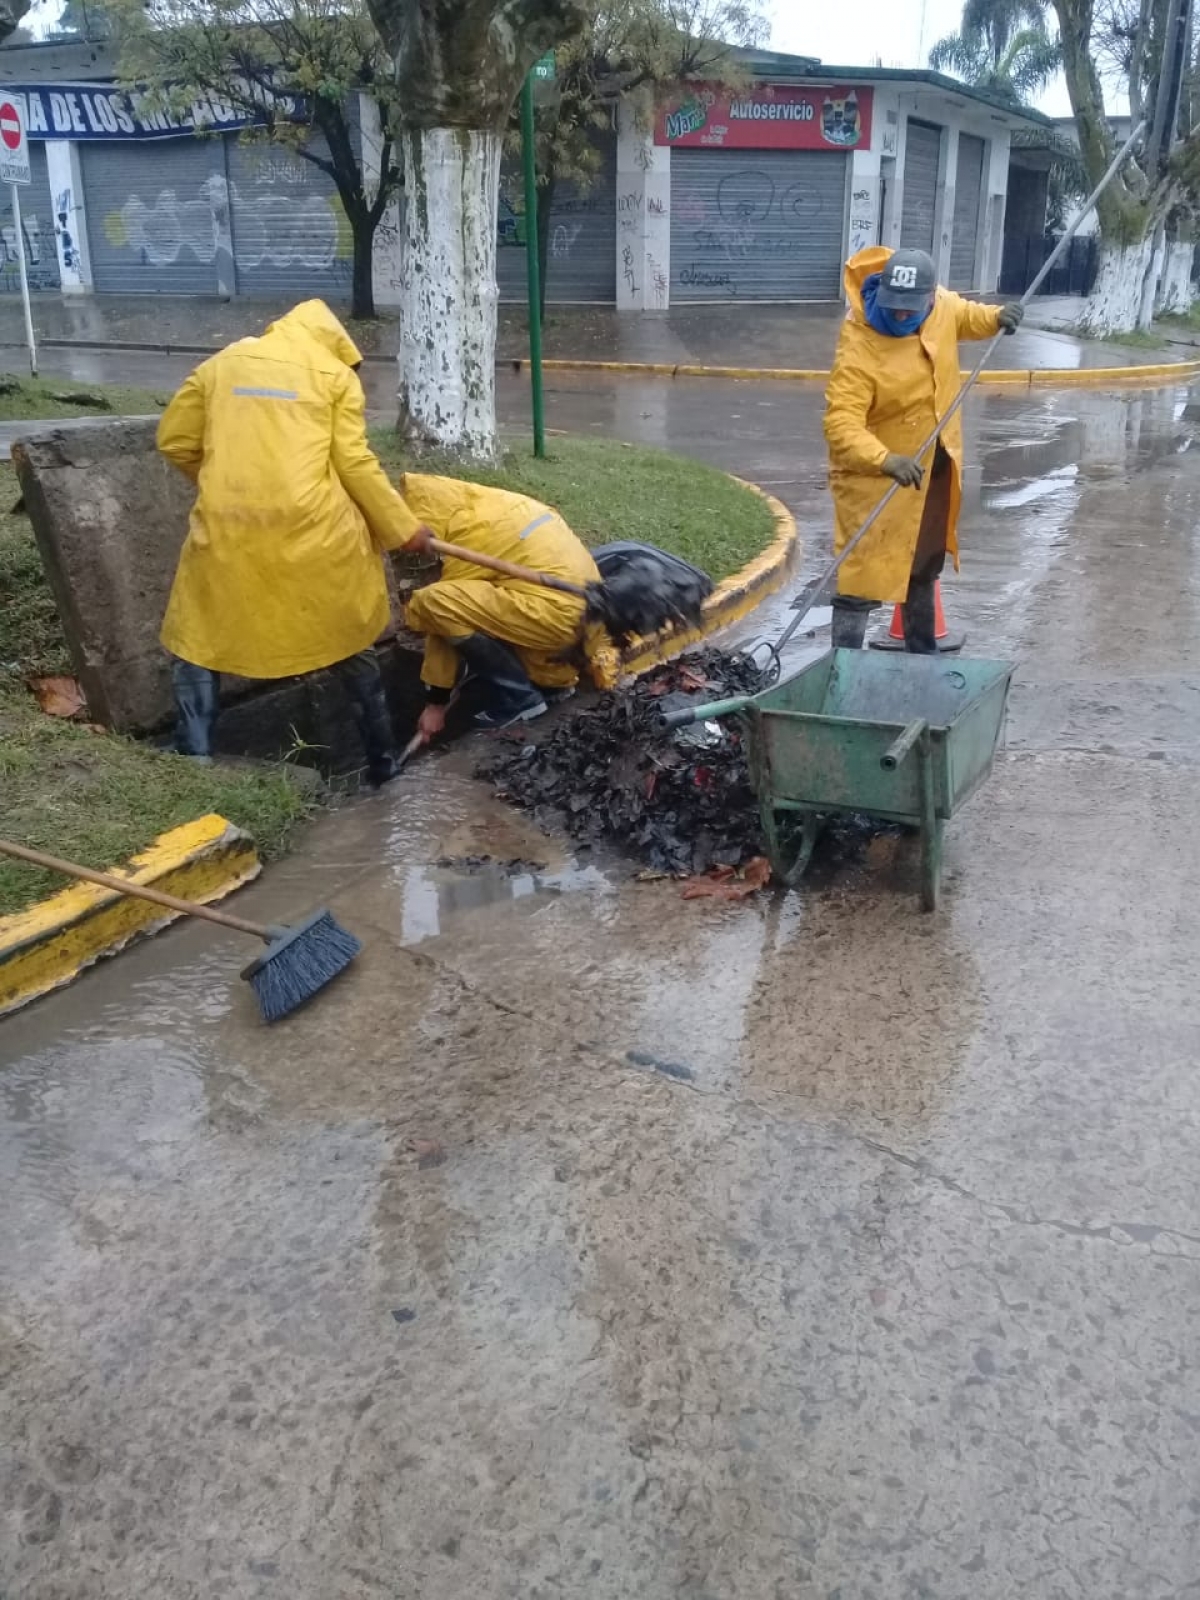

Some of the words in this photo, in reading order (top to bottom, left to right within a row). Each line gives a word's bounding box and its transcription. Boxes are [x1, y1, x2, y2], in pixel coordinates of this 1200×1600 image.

[49, 92, 87, 131] DE
[81, 93, 135, 132] LOS
[729, 99, 814, 120] Autoservicio
